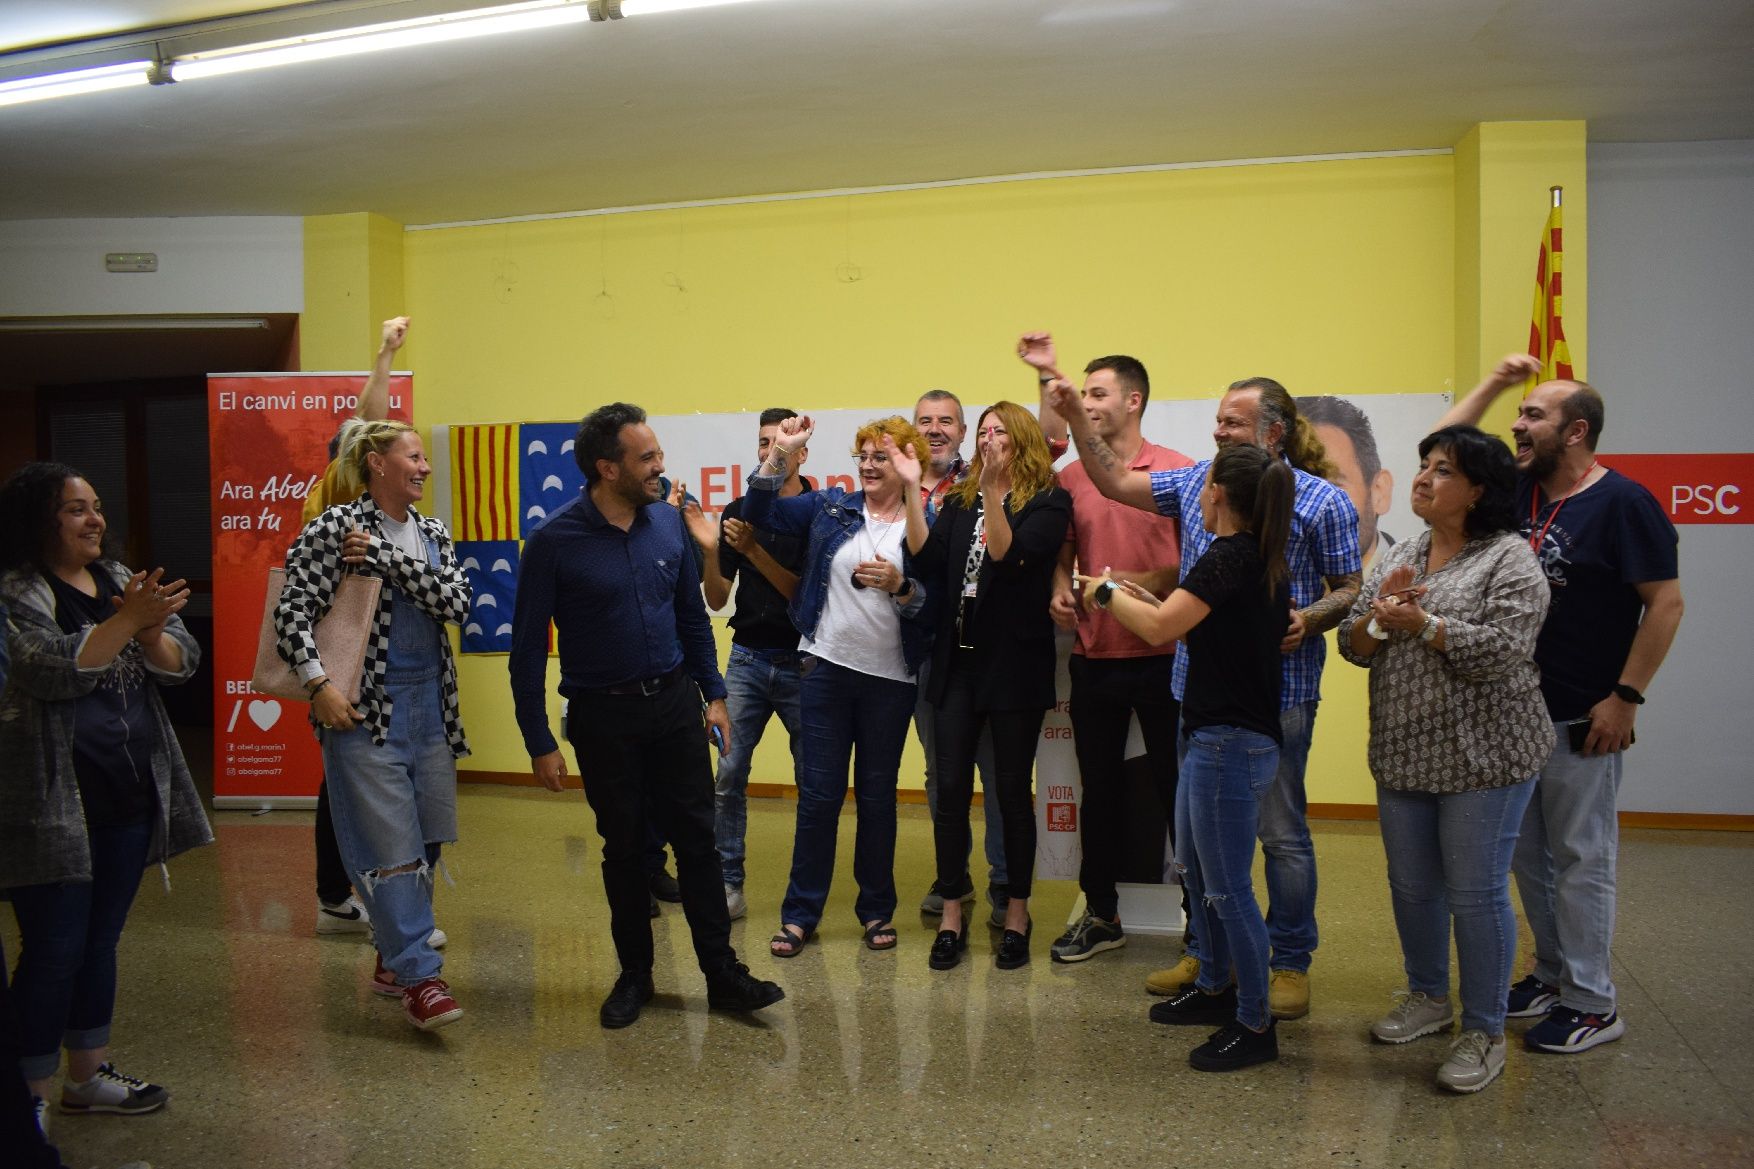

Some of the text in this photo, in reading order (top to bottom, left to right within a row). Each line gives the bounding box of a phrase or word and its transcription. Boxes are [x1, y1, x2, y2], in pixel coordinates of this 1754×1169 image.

[219, 392, 236, 410] El
[243, 391, 296, 410] canvi
[302, 395, 327, 410] en
[220, 473, 317, 502] Ara Abel
[1671, 484, 1741, 516] PSC
[220, 507, 283, 531] ara tu
[1053, 700, 1071, 713] ra
[1044, 727, 1072, 739] ara
[1047, 785, 1074, 800] VOTA
